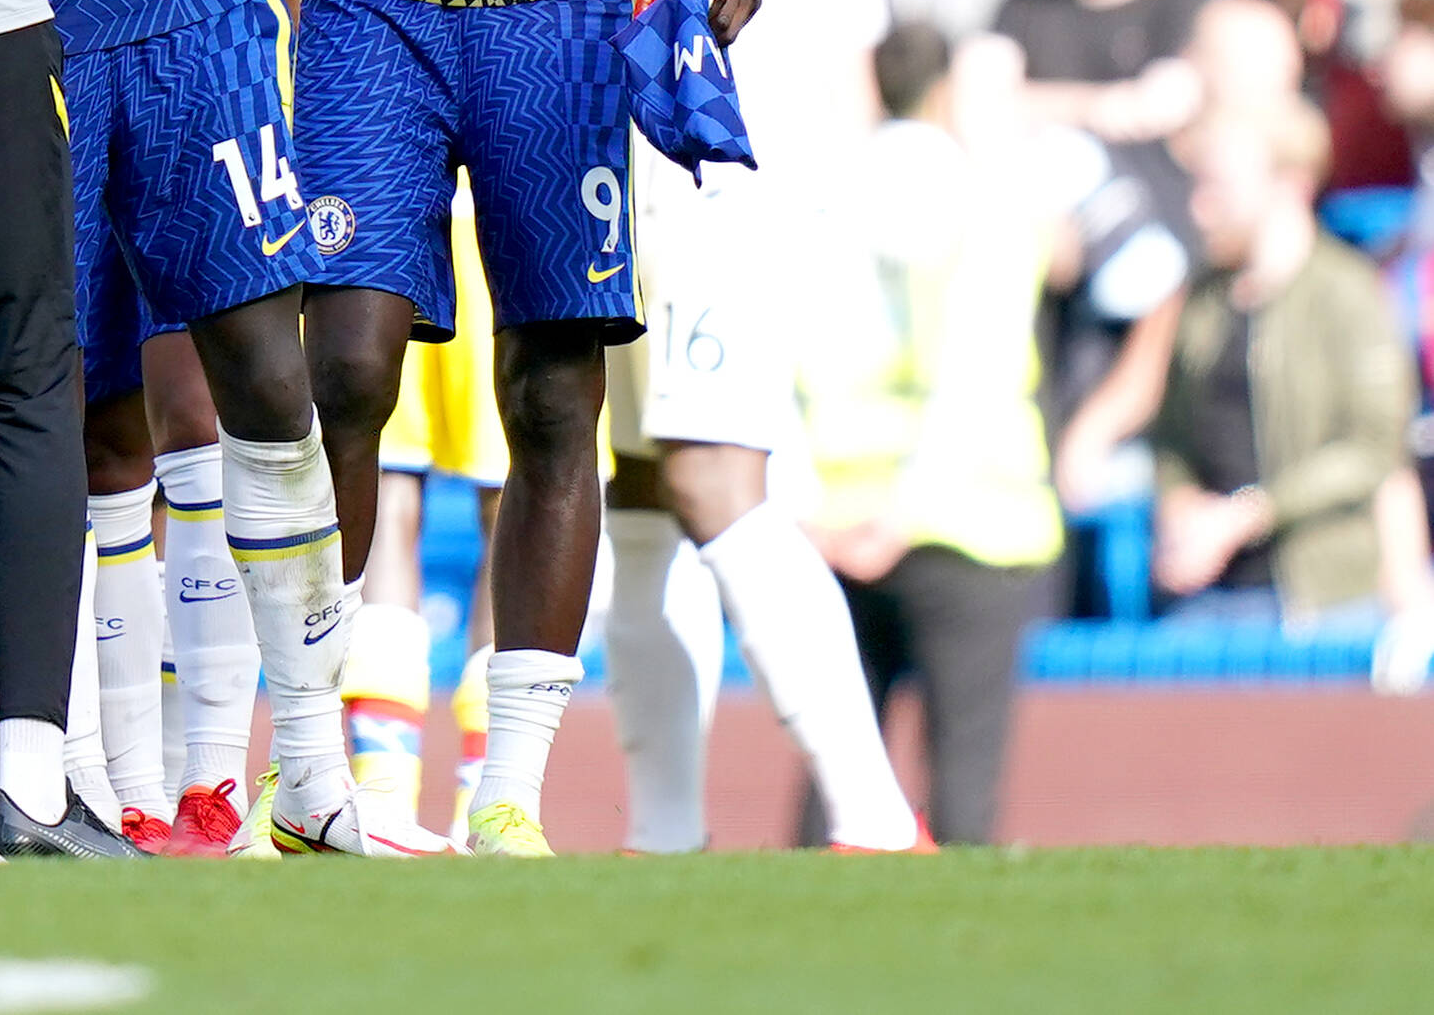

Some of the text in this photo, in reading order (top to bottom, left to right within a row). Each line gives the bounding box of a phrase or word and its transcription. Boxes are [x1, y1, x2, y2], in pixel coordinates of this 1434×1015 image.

[212, 123, 304, 228] 14
[580, 166, 622, 253] 9
[666, 301, 724, 372] 16
[181, 576, 237, 591] CFC
[304, 600, 343, 626] CFC
